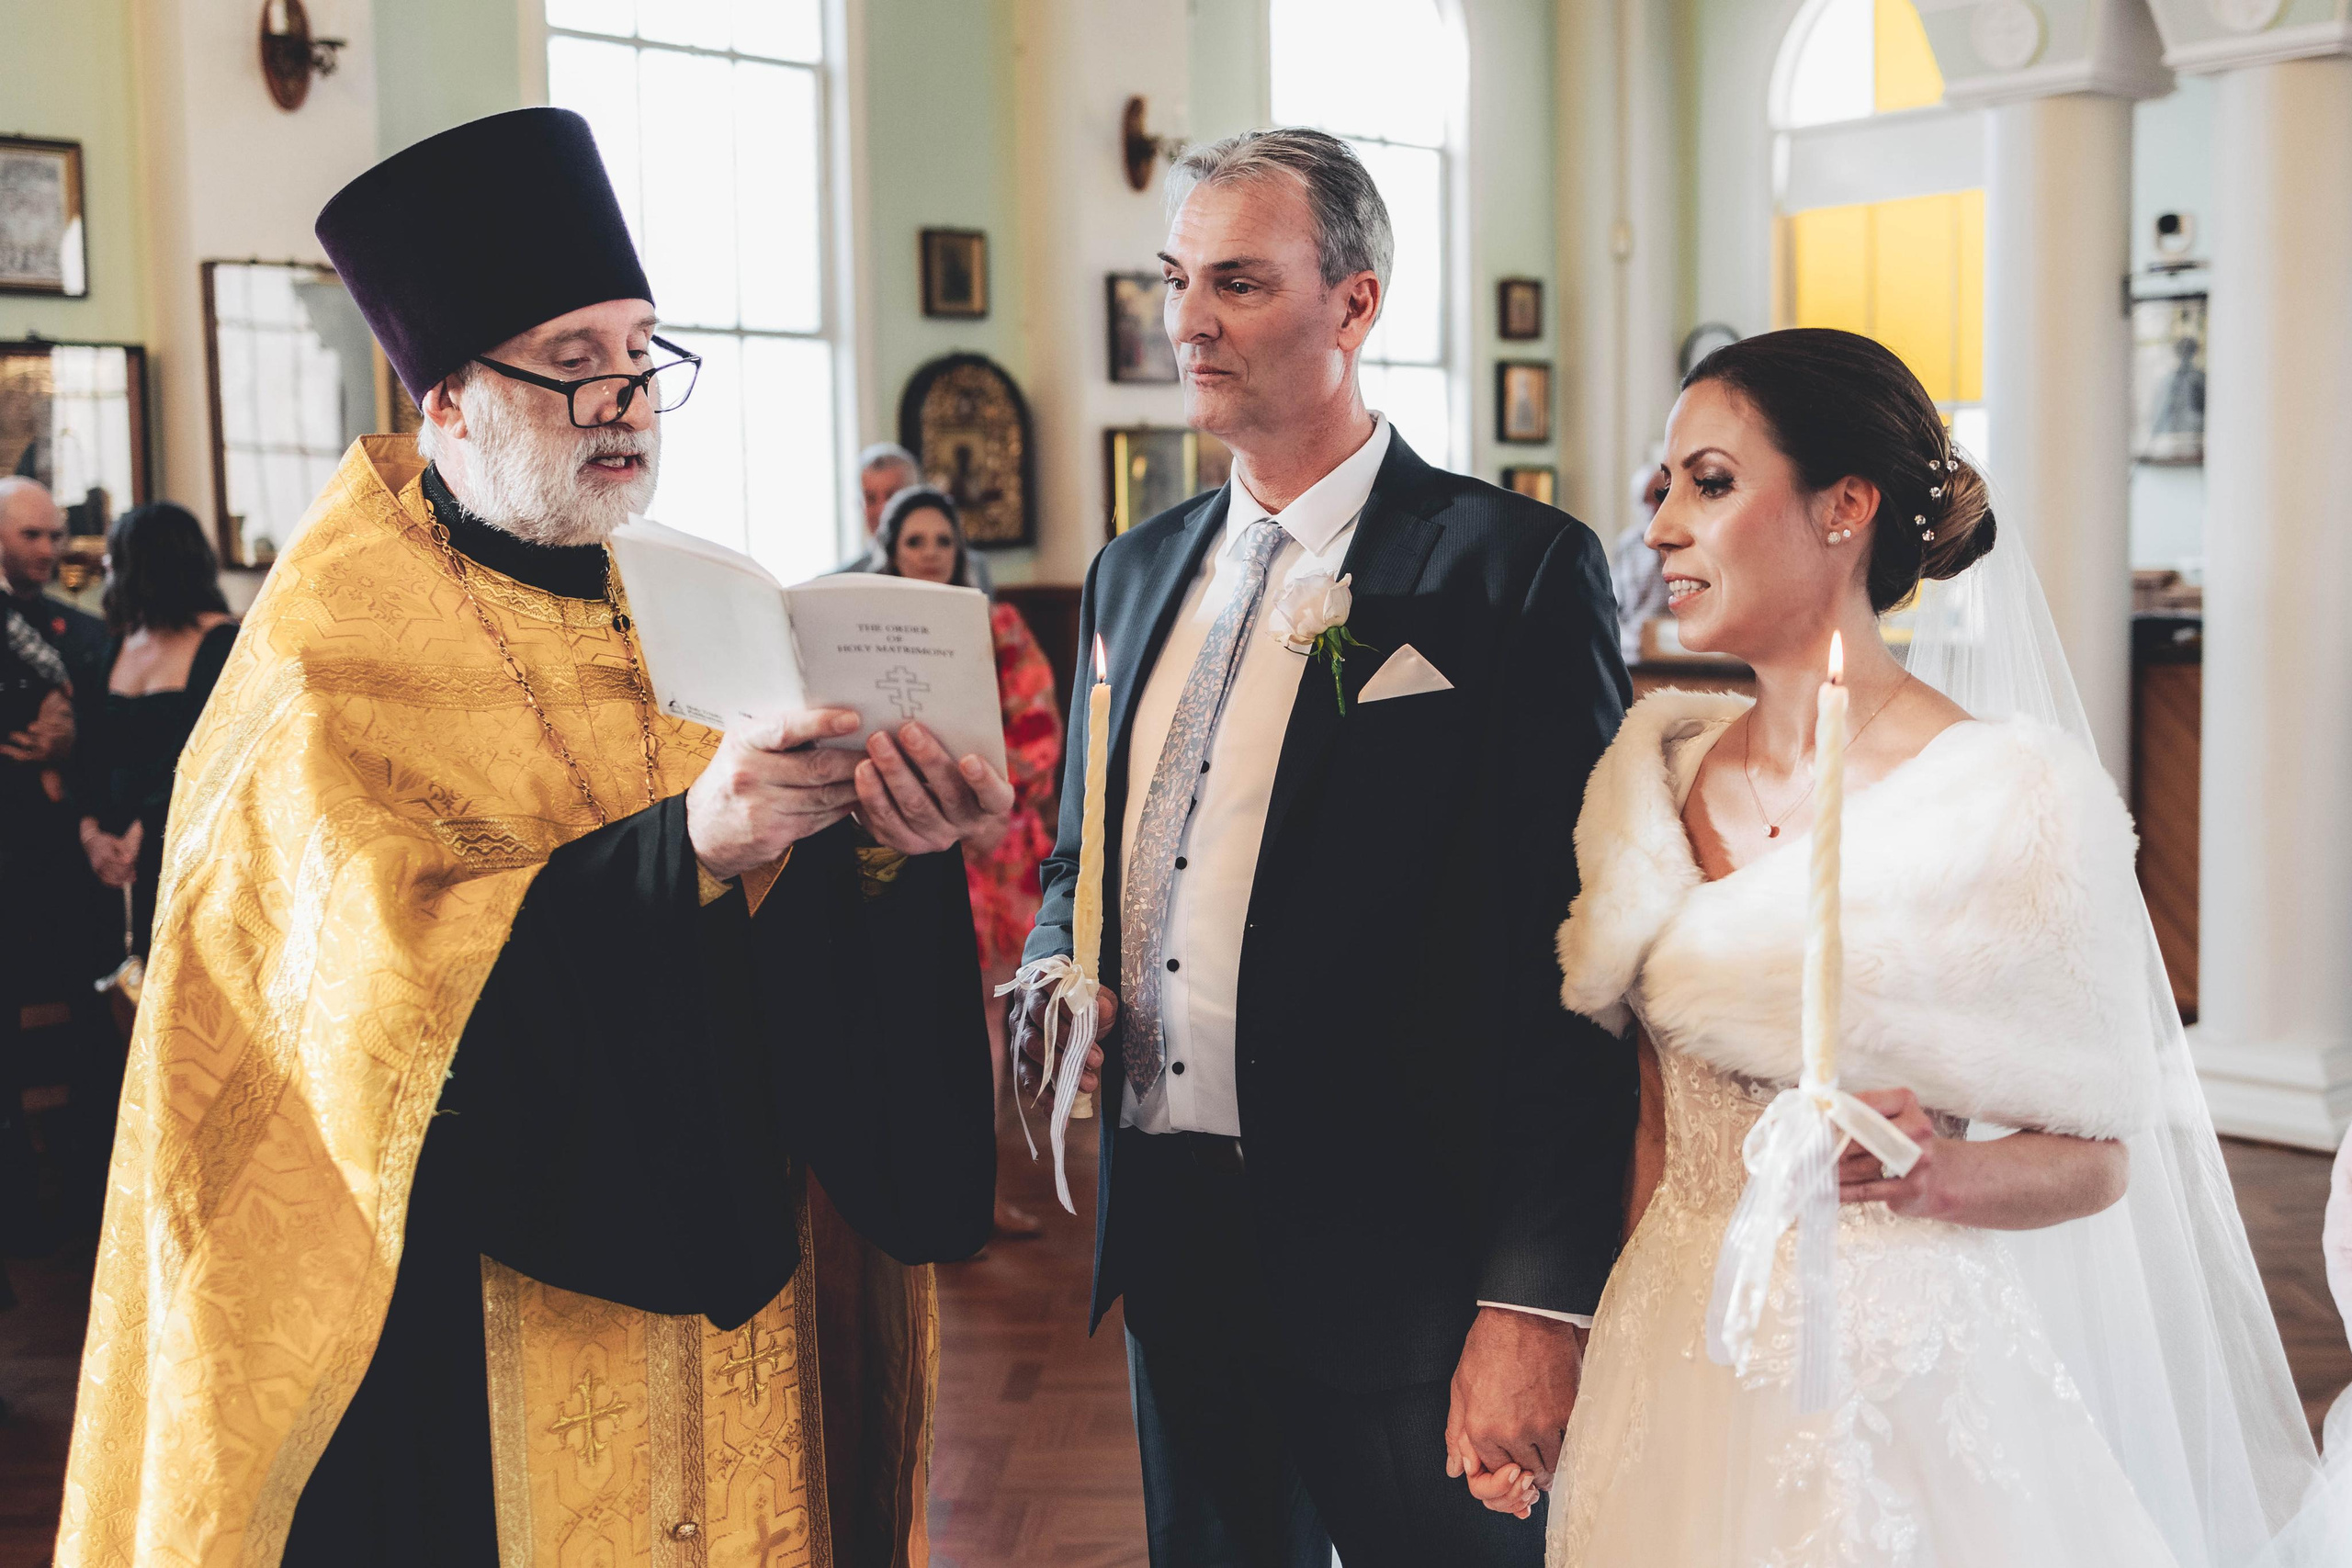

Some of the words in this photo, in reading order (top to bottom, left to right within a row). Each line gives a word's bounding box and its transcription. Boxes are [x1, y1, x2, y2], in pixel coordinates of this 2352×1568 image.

[857, 624, 882, 632] THE
[885, 625, 930, 634] ORDER
[837, 645, 872, 653] HOLY
[876, 646, 955, 657] MATRIMONY
